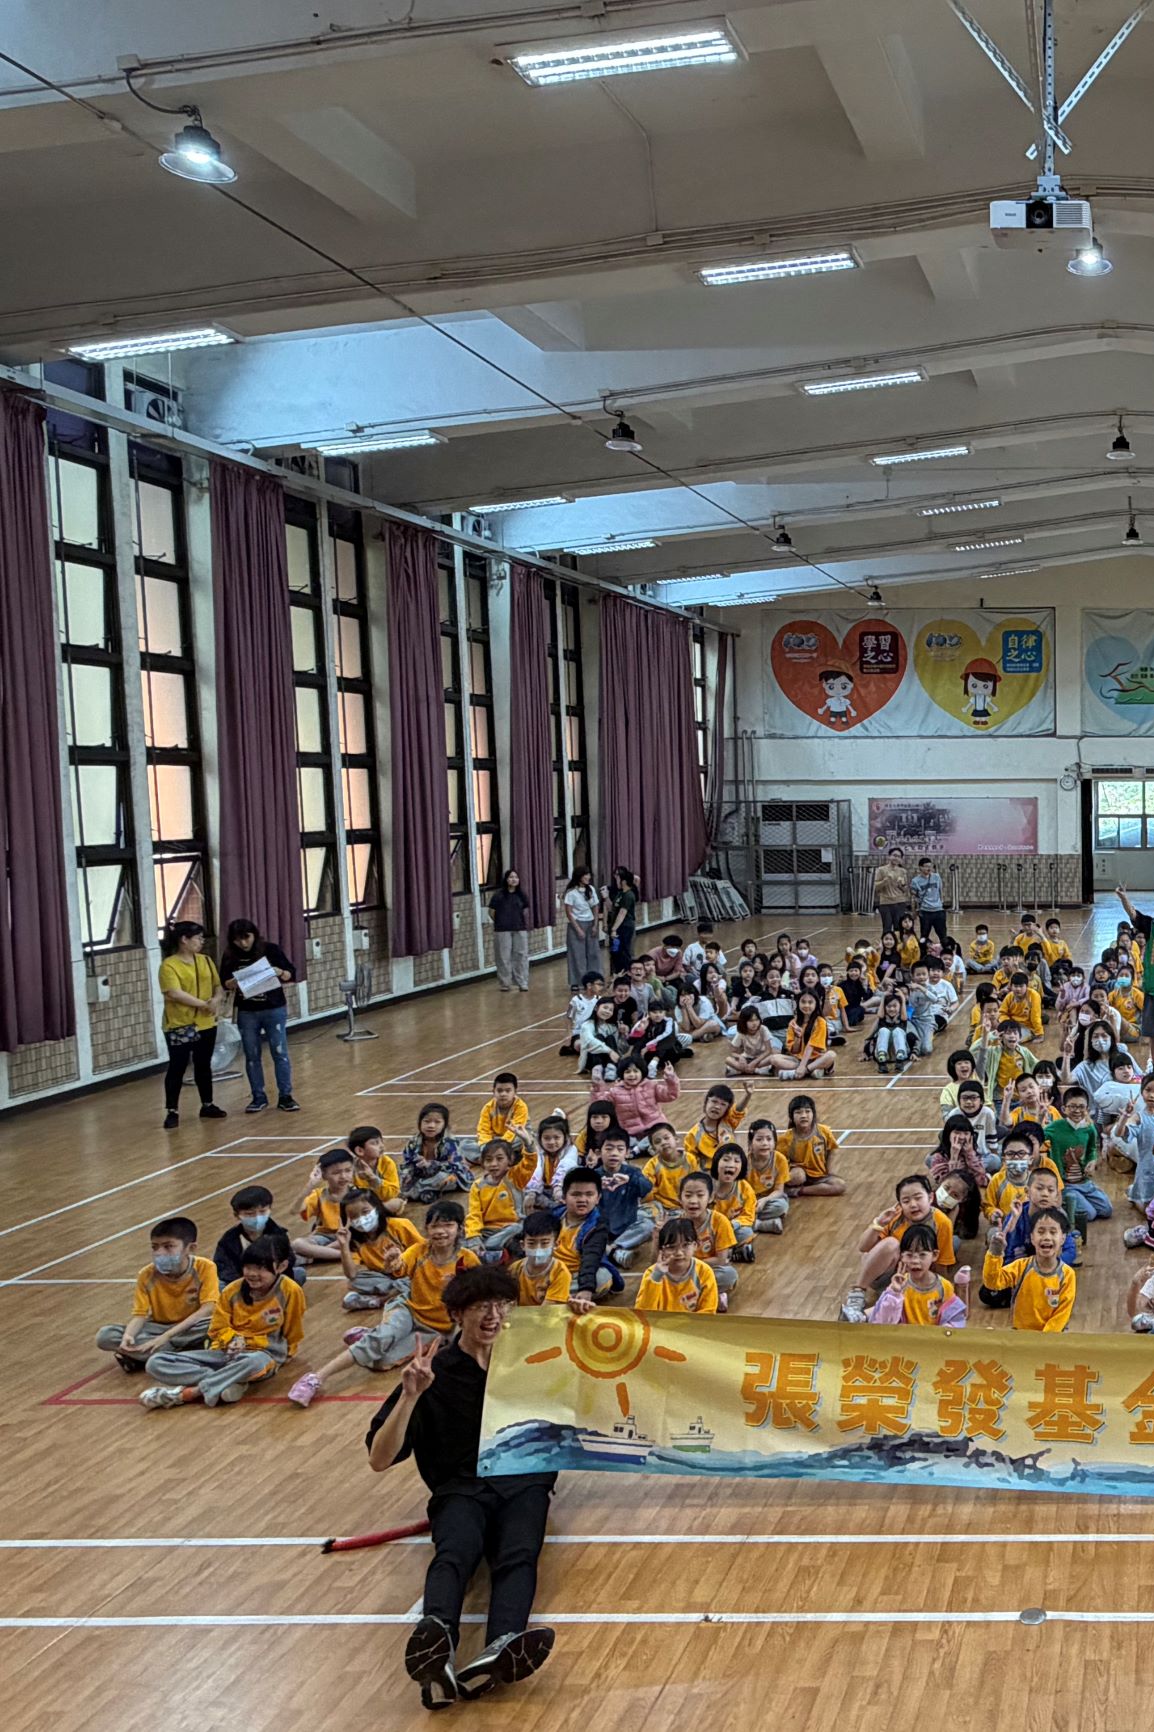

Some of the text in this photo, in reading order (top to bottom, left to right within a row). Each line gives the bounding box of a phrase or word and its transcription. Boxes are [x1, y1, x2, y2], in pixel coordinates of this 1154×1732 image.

[862, 634, 892, 651] 學習
[1007, 633, 1038, 649] 自律
[862, 651, 893, 663] 之心
[1006, 649, 1037, 662] 之心
